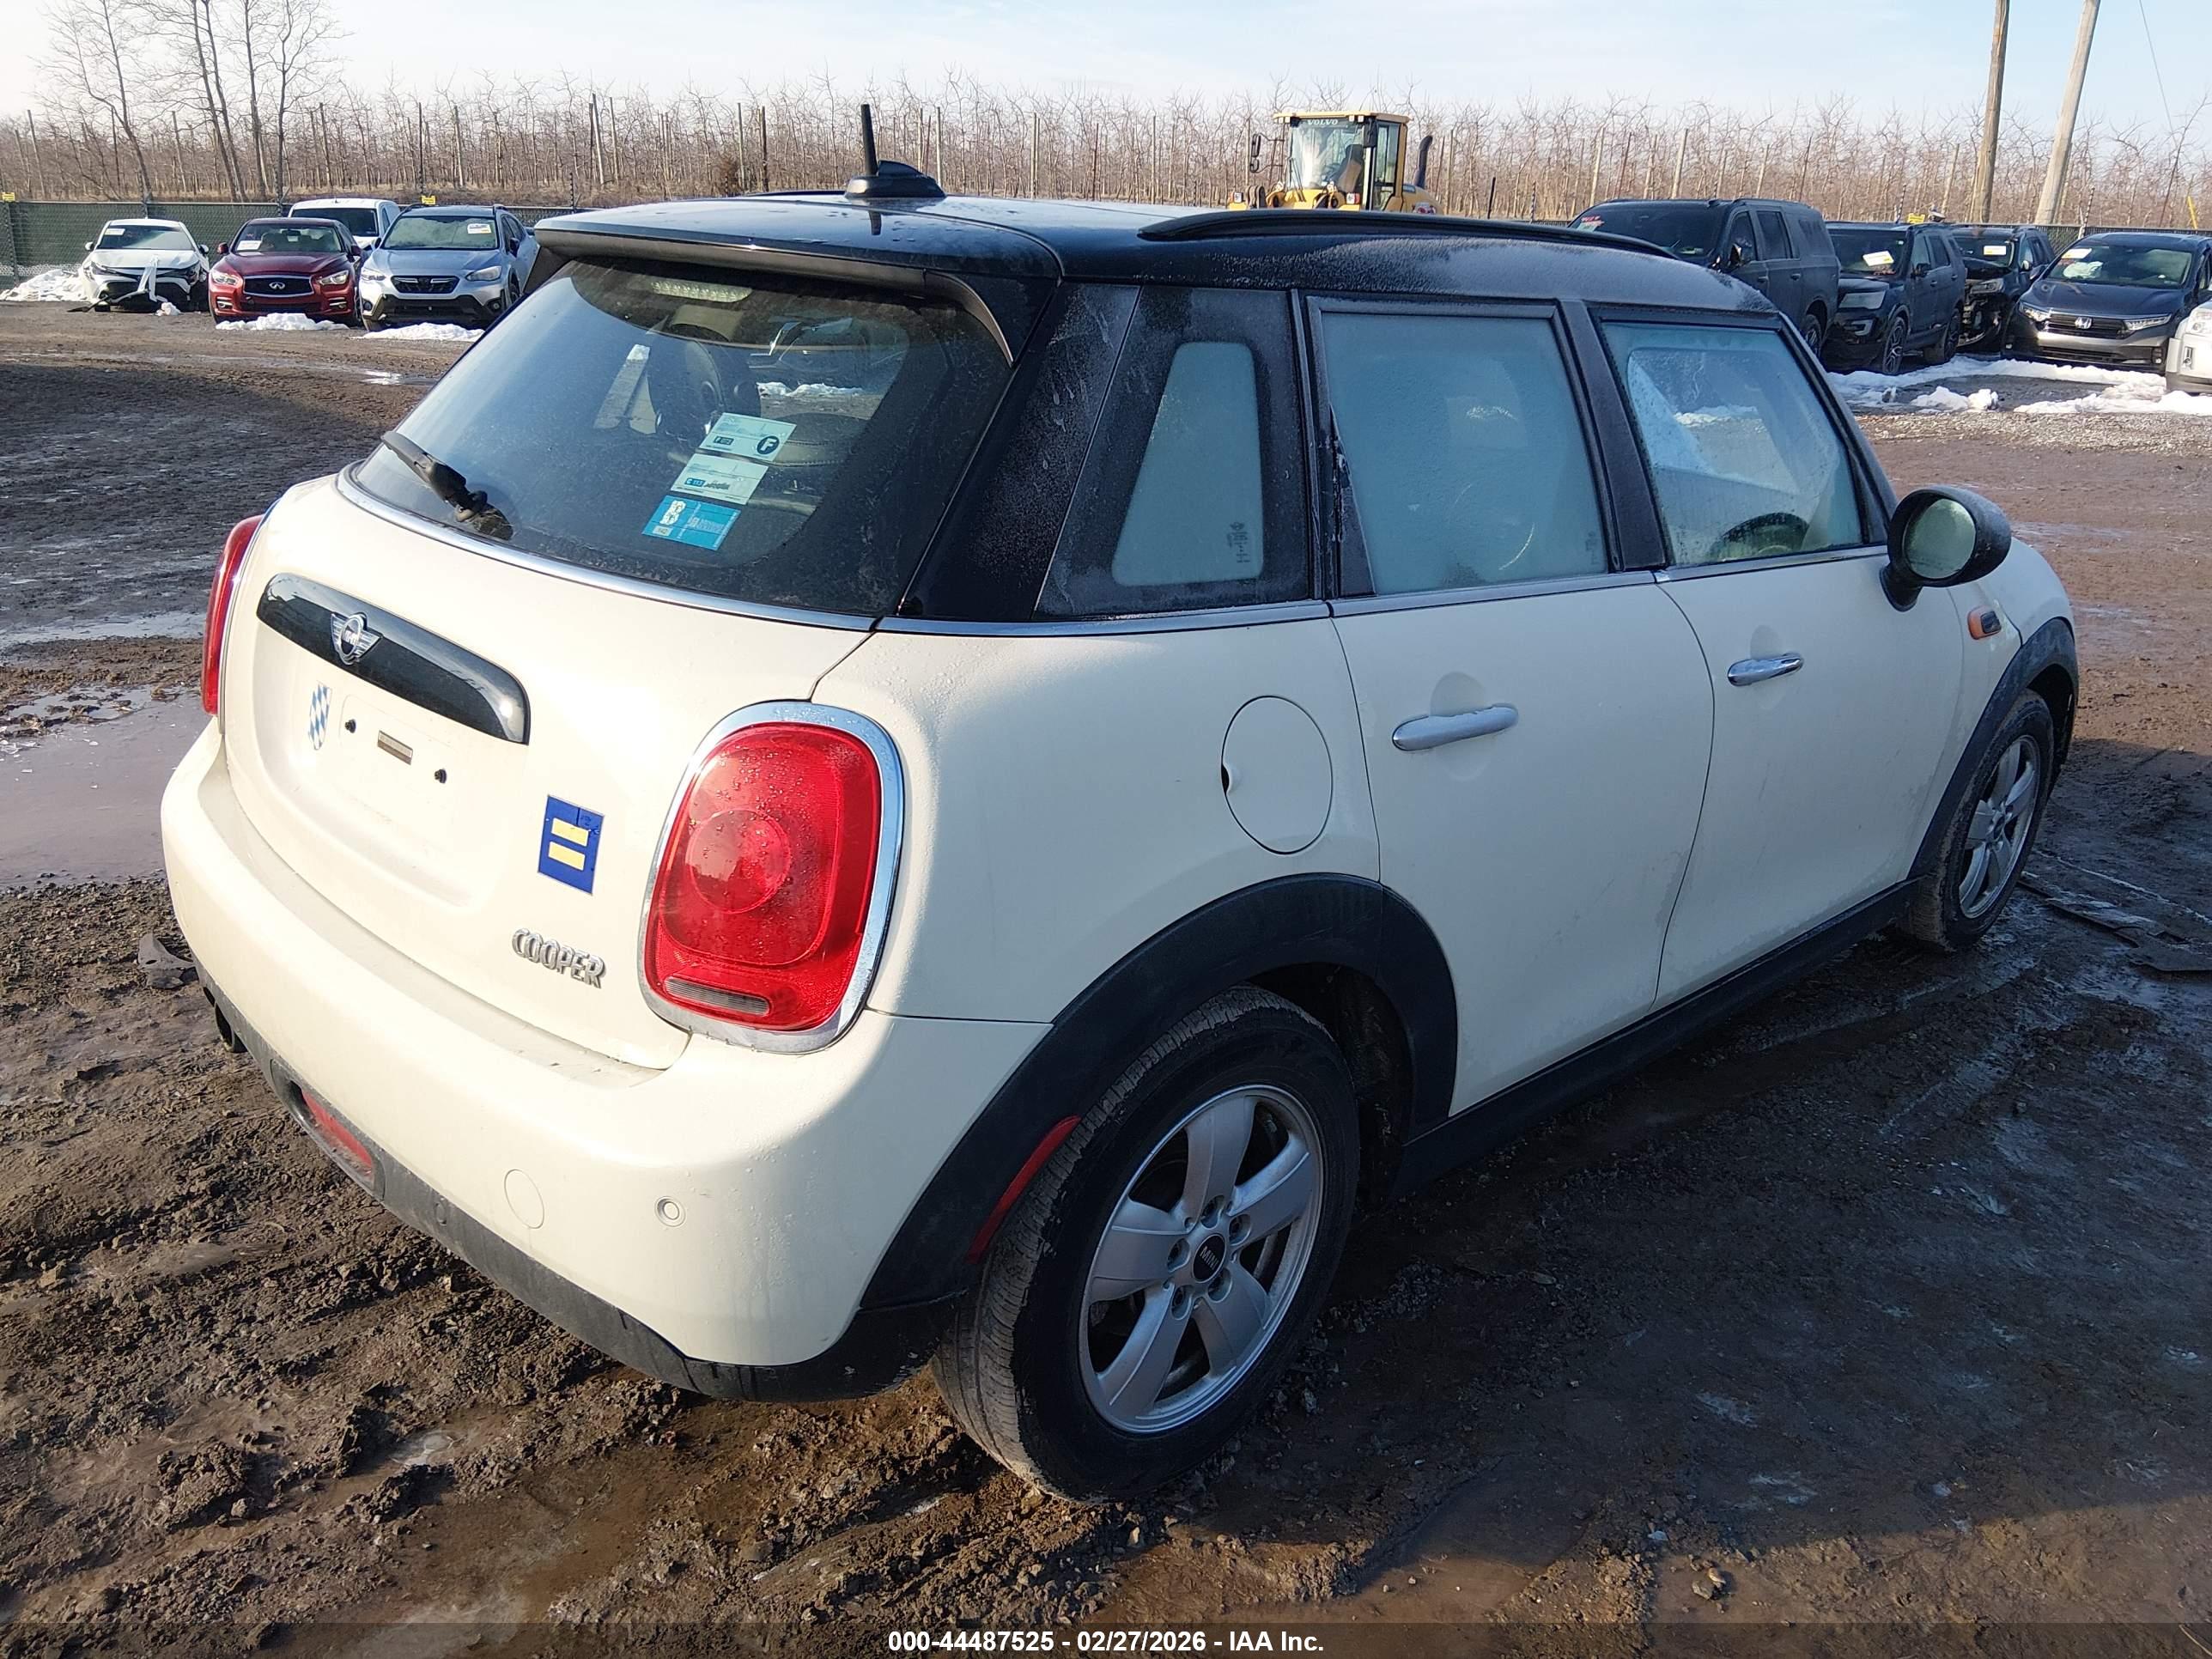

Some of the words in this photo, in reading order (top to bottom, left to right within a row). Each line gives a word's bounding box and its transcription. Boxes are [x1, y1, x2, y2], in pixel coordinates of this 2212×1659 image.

[761, 437, 777, 452] F
[512, 927, 606, 989] COOPER
[1200, 1245, 1219, 1270] MINI
